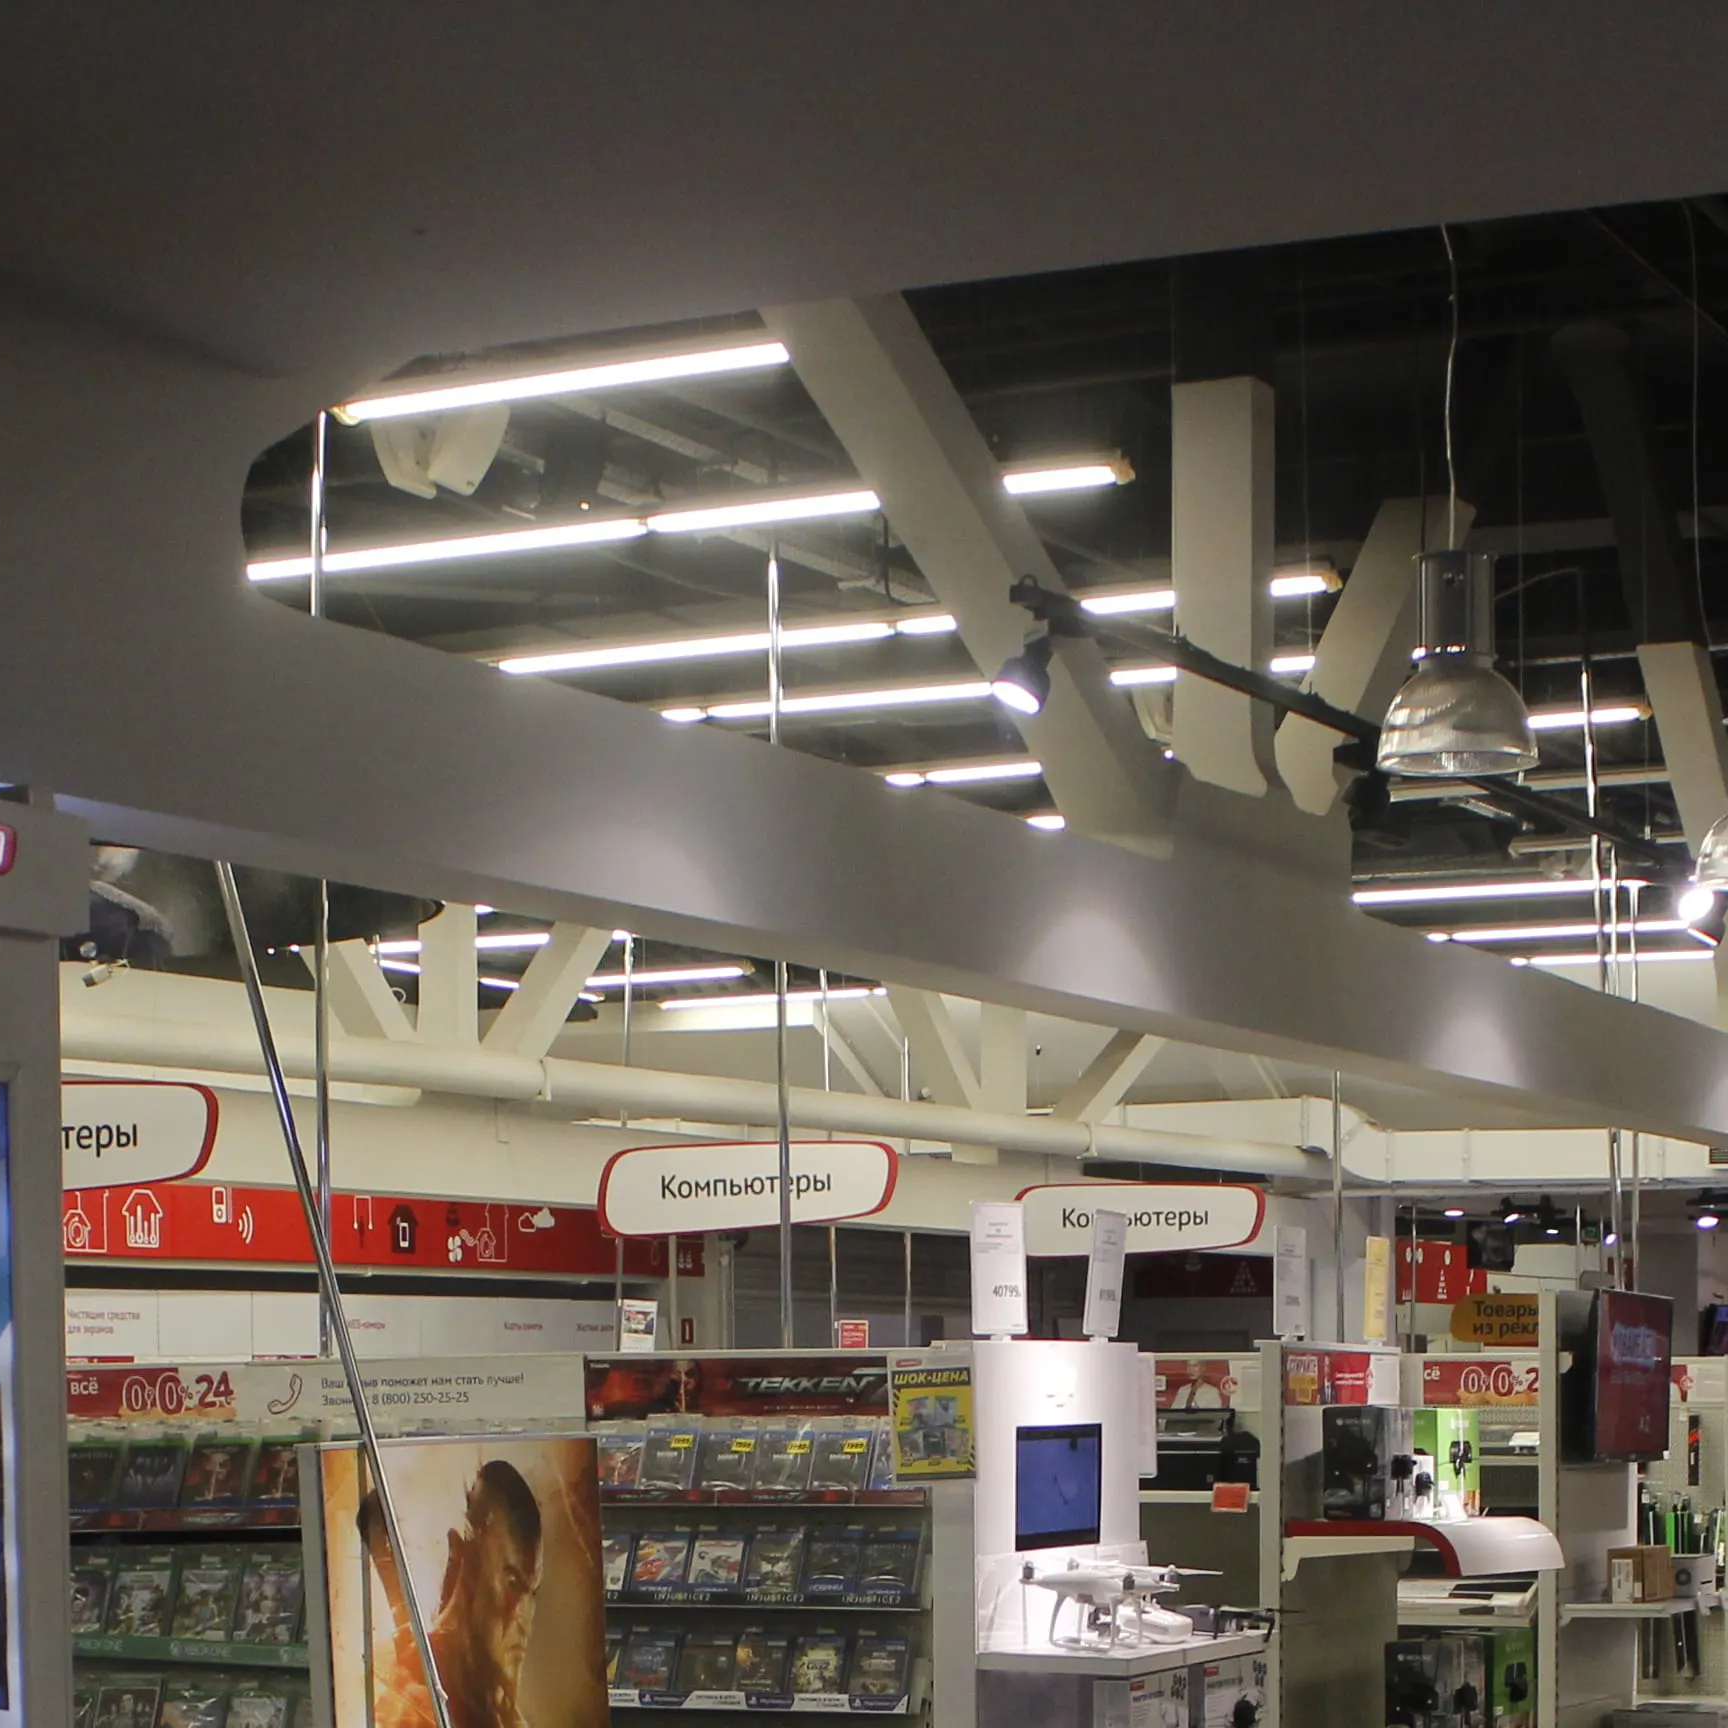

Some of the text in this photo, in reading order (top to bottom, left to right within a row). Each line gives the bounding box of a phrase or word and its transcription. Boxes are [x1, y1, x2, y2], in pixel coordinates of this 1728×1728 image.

[660, 1171, 832, 1201] Компьютеры
[1062, 1207, 1210, 1231] Коьютеры
[1473, 1322, 1495, 1334] из
[321, 1377, 345, 1389] Ваш
[381, 1377, 427, 1388] поможет
[431, 1377, 452, 1387] нам
[456, 1376, 484, 1387] стать
[893, 1367, 970, 1385] ШОК-ЦЕНА
[70, 1376, 99, 1395] всё
[372, 1394, 379, 1405] 8
[382, 1392, 411, 1407] (800)
[413, 1391, 470, 1405] 250-25-25
